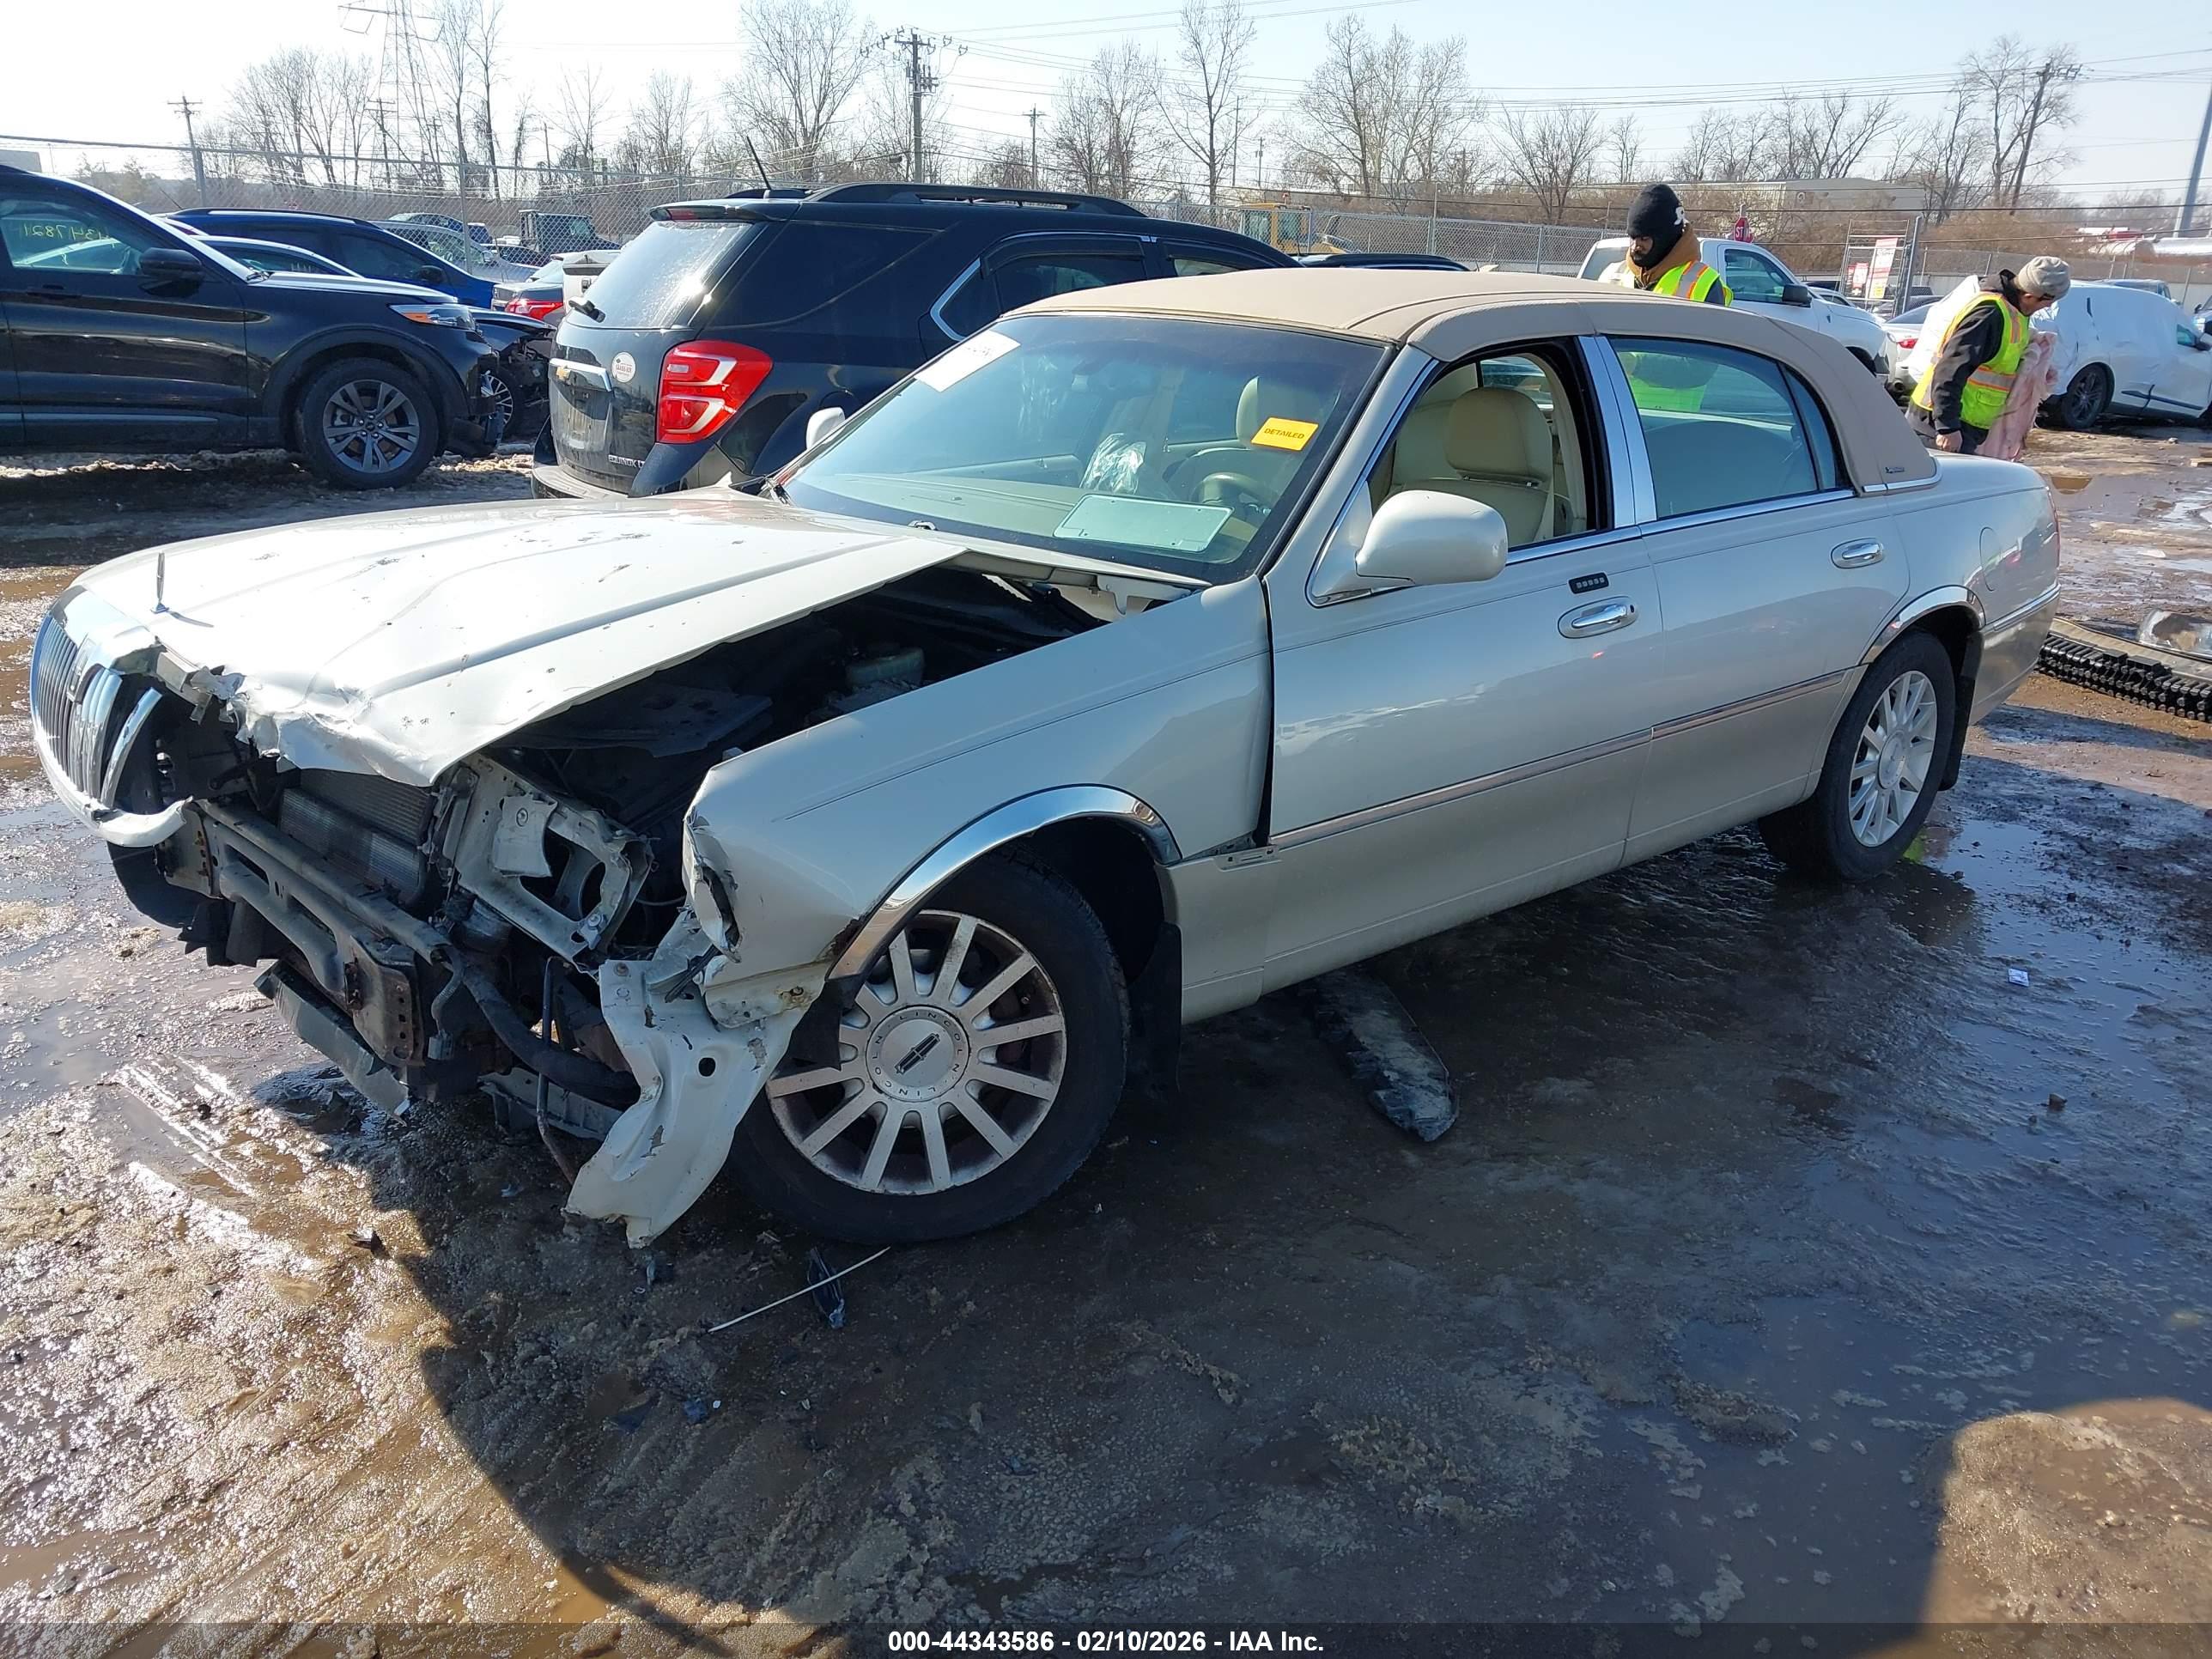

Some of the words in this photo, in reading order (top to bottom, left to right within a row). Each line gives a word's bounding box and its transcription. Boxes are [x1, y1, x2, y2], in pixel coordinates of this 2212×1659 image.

[1264, 428, 1305, 440] DETAILED
[608, 454, 636, 468] EQUINOX
[899, 1012, 963, 1073] LINCOLN
[872, 1036, 936, 1096] LINCOLN
